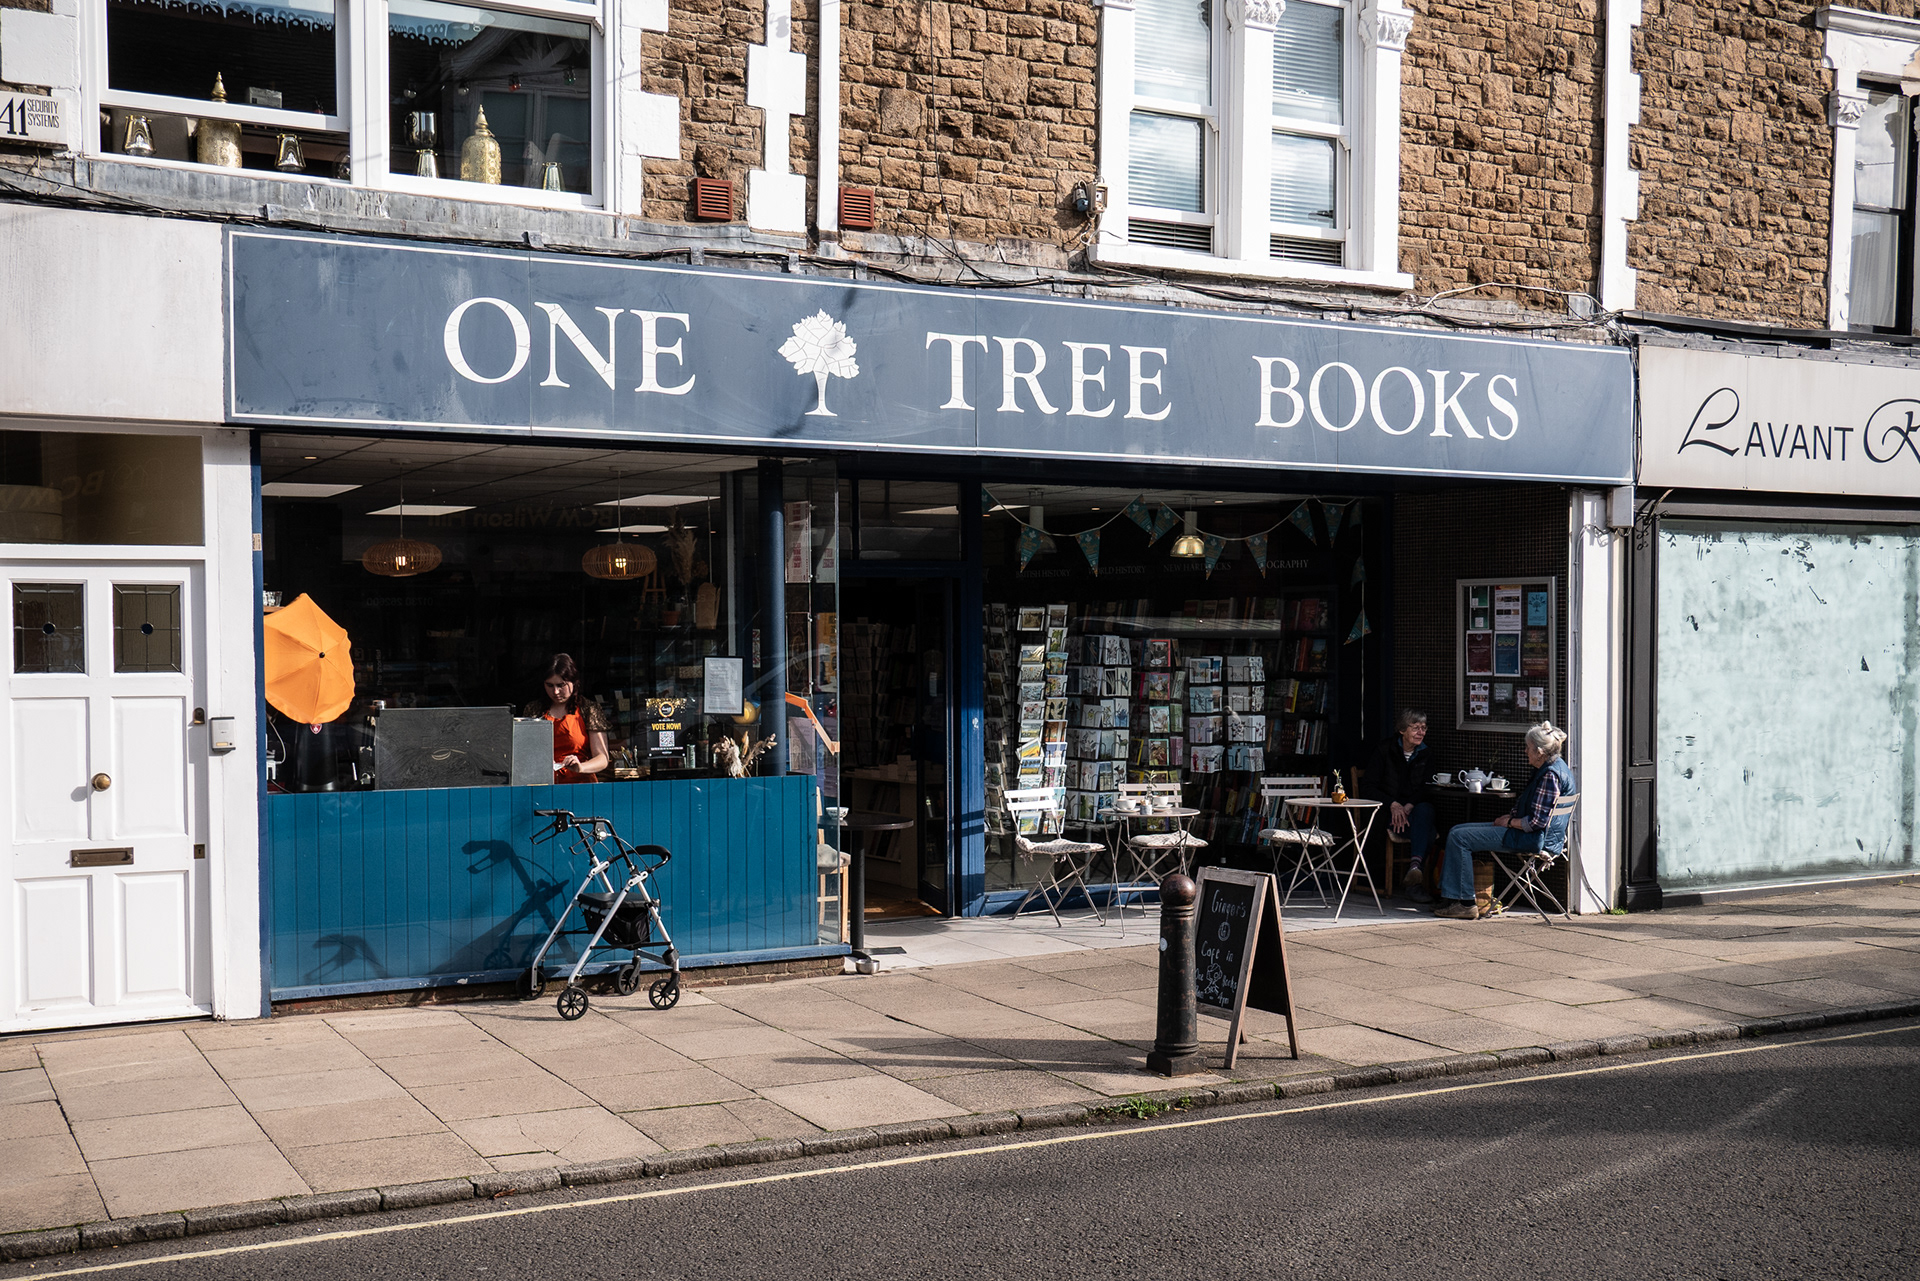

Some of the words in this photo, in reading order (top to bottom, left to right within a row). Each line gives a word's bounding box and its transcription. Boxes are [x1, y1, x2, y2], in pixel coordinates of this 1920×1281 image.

[27, 98, 59, 114] SECURITY
[28, 113, 60, 129] SYSTEMS
[443, 296, 696, 396] ONE
[925, 330, 1173, 422] TREE
[1251, 354, 1520, 442] BOOKS
[1677, 387, 1855, 462] LAVANT
[1088, 566, 1114, 576] WRLD
[1266, 559, 1310, 569] OGRAPHY
[651, 722, 666, 731] VOTE
[666, 722, 682, 730] NOW!
